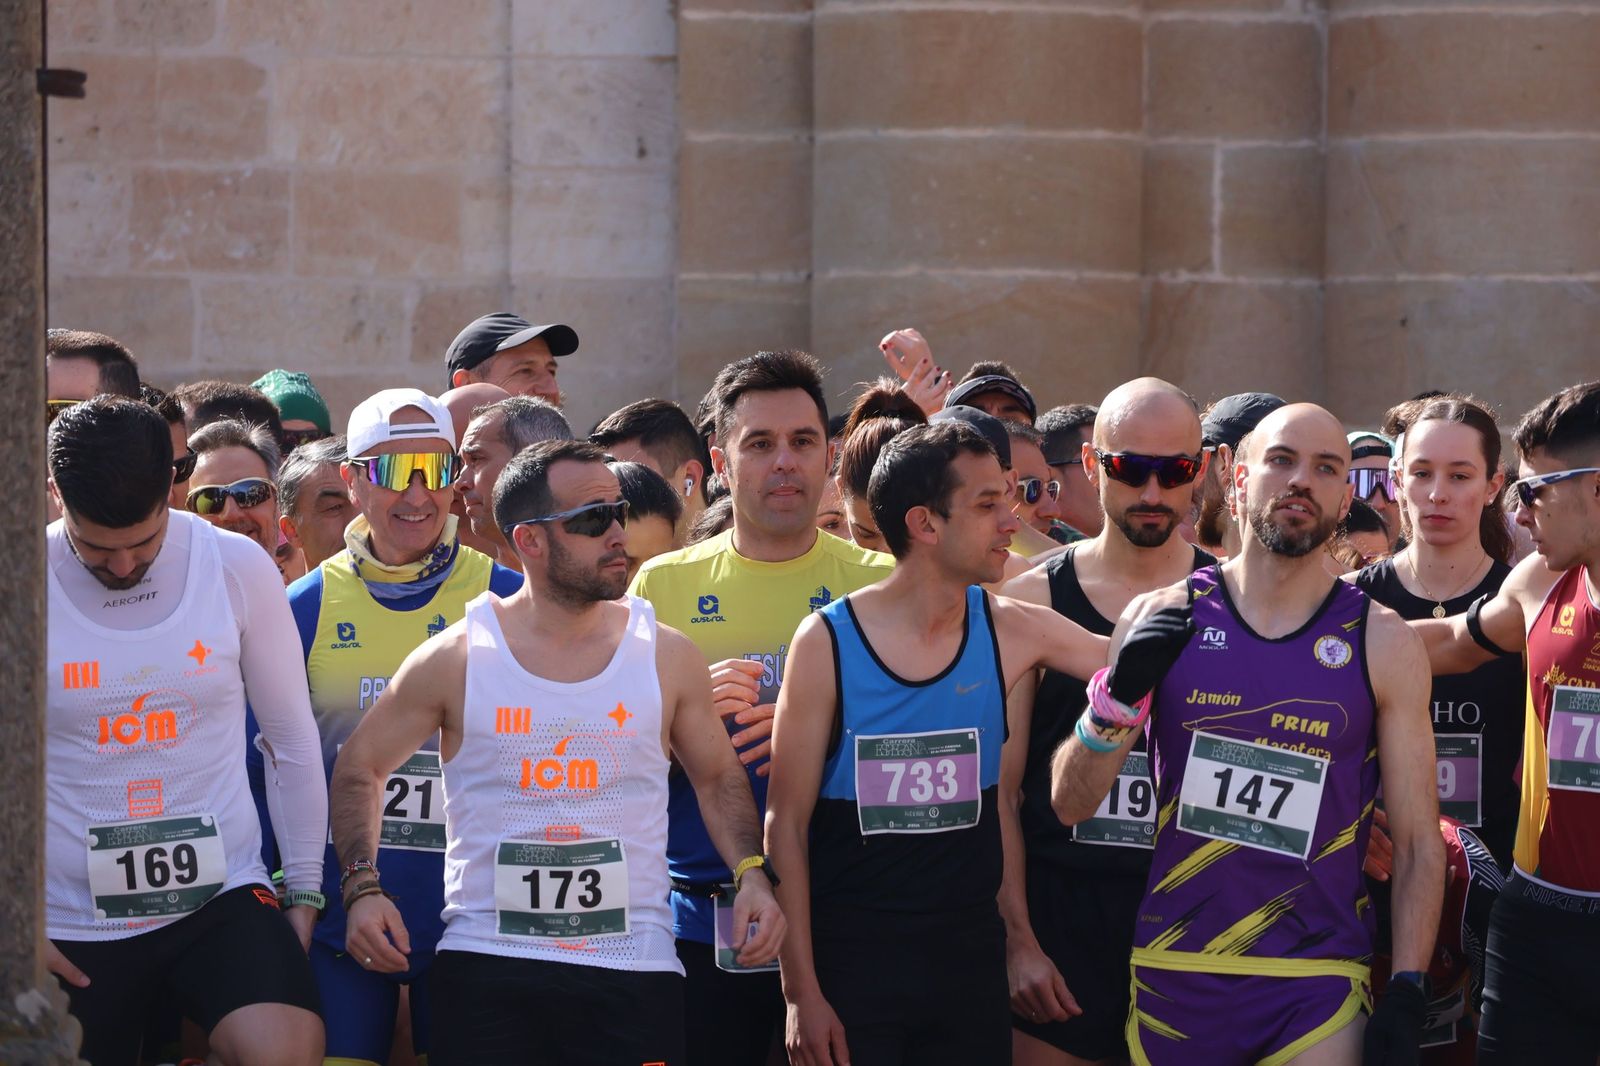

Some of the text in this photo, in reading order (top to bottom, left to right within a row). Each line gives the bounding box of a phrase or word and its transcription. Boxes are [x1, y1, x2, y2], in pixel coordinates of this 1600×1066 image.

[102, 591, 159, 608] AEROFIT
[1186, 689, 1242, 706] Jamón
[1433, 701, 1480, 725] HO
[1271, 713, 1330, 737] PRIM
[881, 759, 958, 803] 733
[1214, 768, 1295, 820] 147
[116, 843, 199, 890] 169
[522, 869, 602, 910] 173
